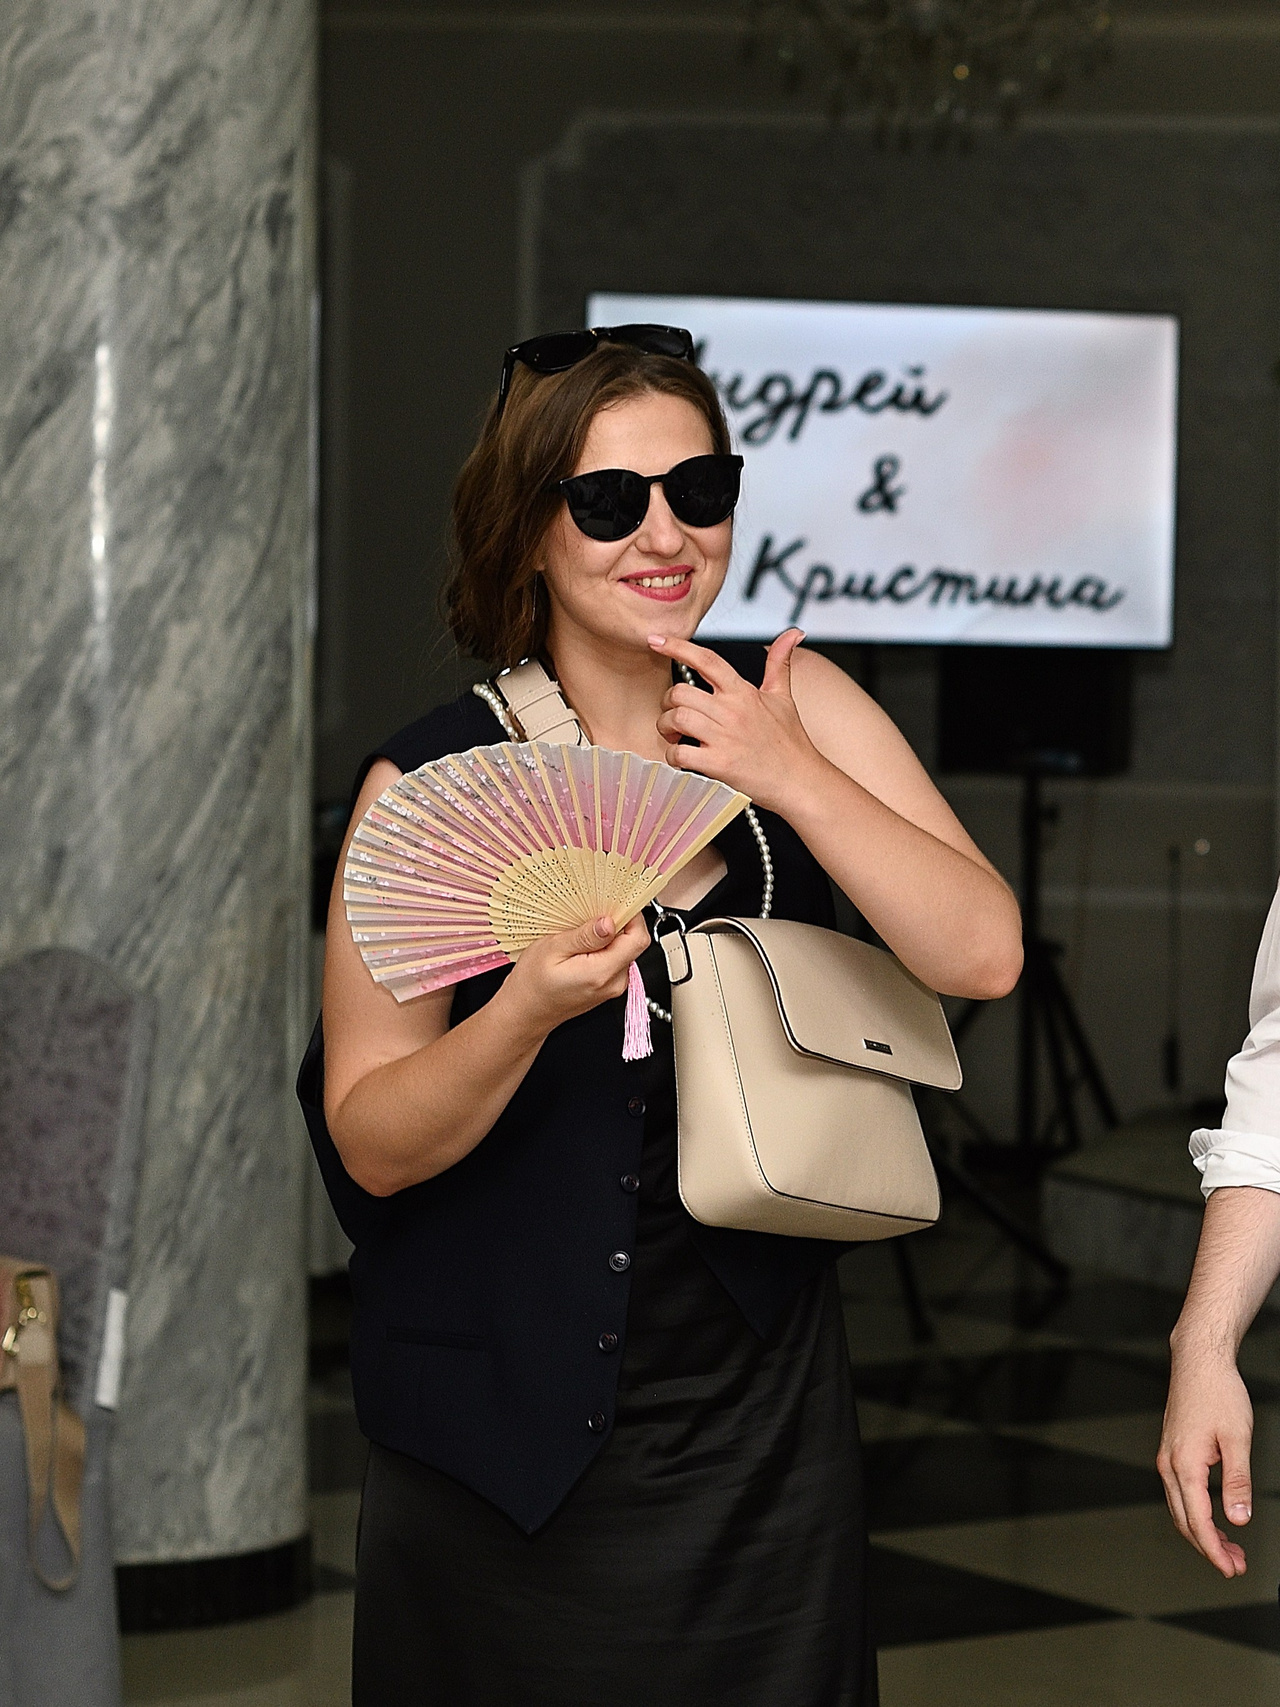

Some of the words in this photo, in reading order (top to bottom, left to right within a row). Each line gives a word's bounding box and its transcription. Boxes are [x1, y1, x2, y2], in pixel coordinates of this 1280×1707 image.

[694, 338, 947, 446] ндрей
[856, 450, 906, 517] &
[743, 530, 1127, 624] Кристина
